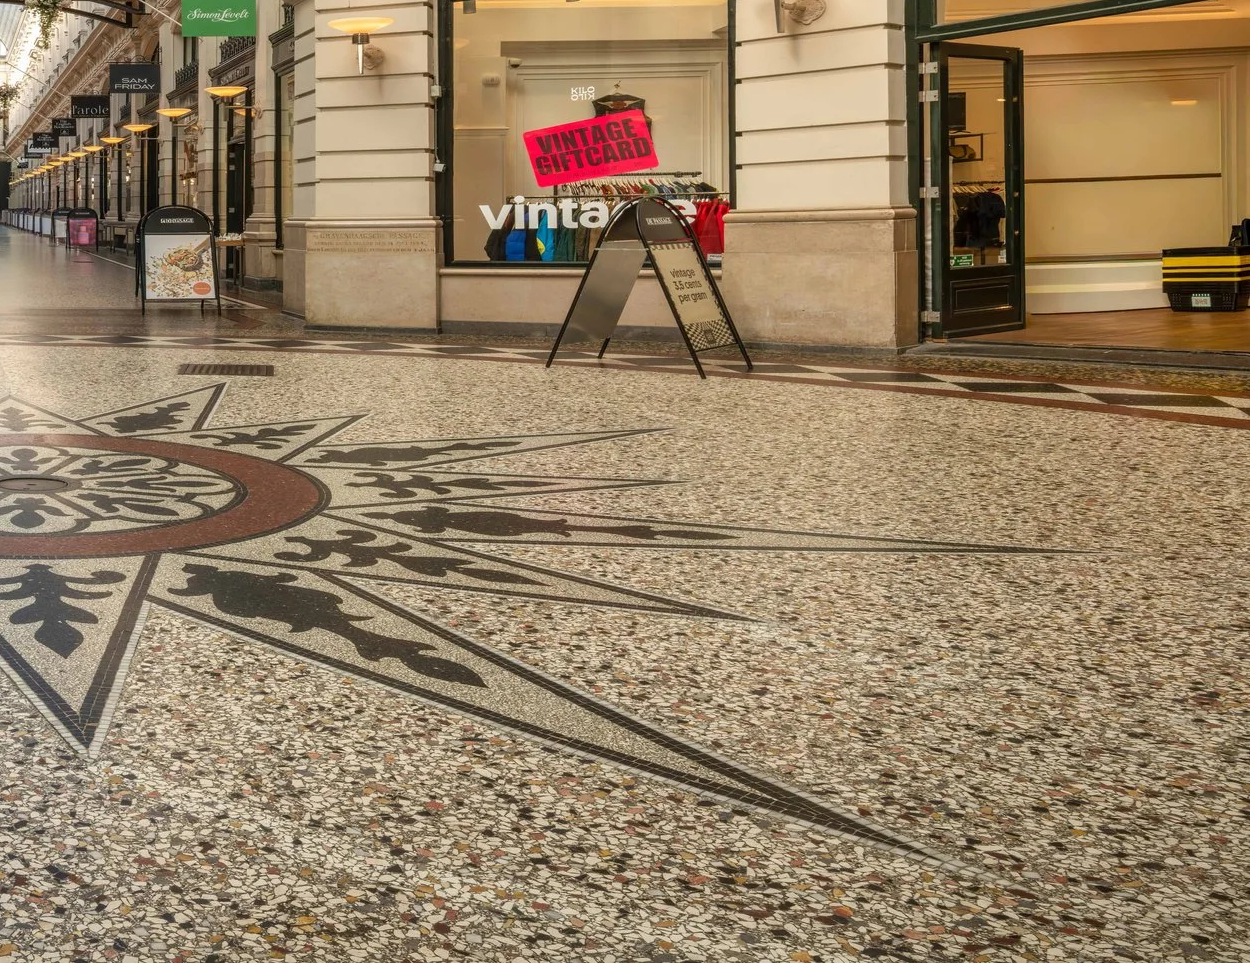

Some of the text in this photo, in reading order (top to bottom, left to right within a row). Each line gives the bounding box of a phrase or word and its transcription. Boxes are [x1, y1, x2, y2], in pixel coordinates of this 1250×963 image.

[186, 8, 221, 20] Simon
[570, 86, 595, 95] KILO
[536, 118, 638, 155] VINTAGE
[535, 138, 651, 176] GIFTCARD
[479, 195, 697, 230] vintae
[670, 269, 696, 279] vintage
[673, 280, 702, 291] 3,5 cents
[678, 291, 708, 304] per gram
